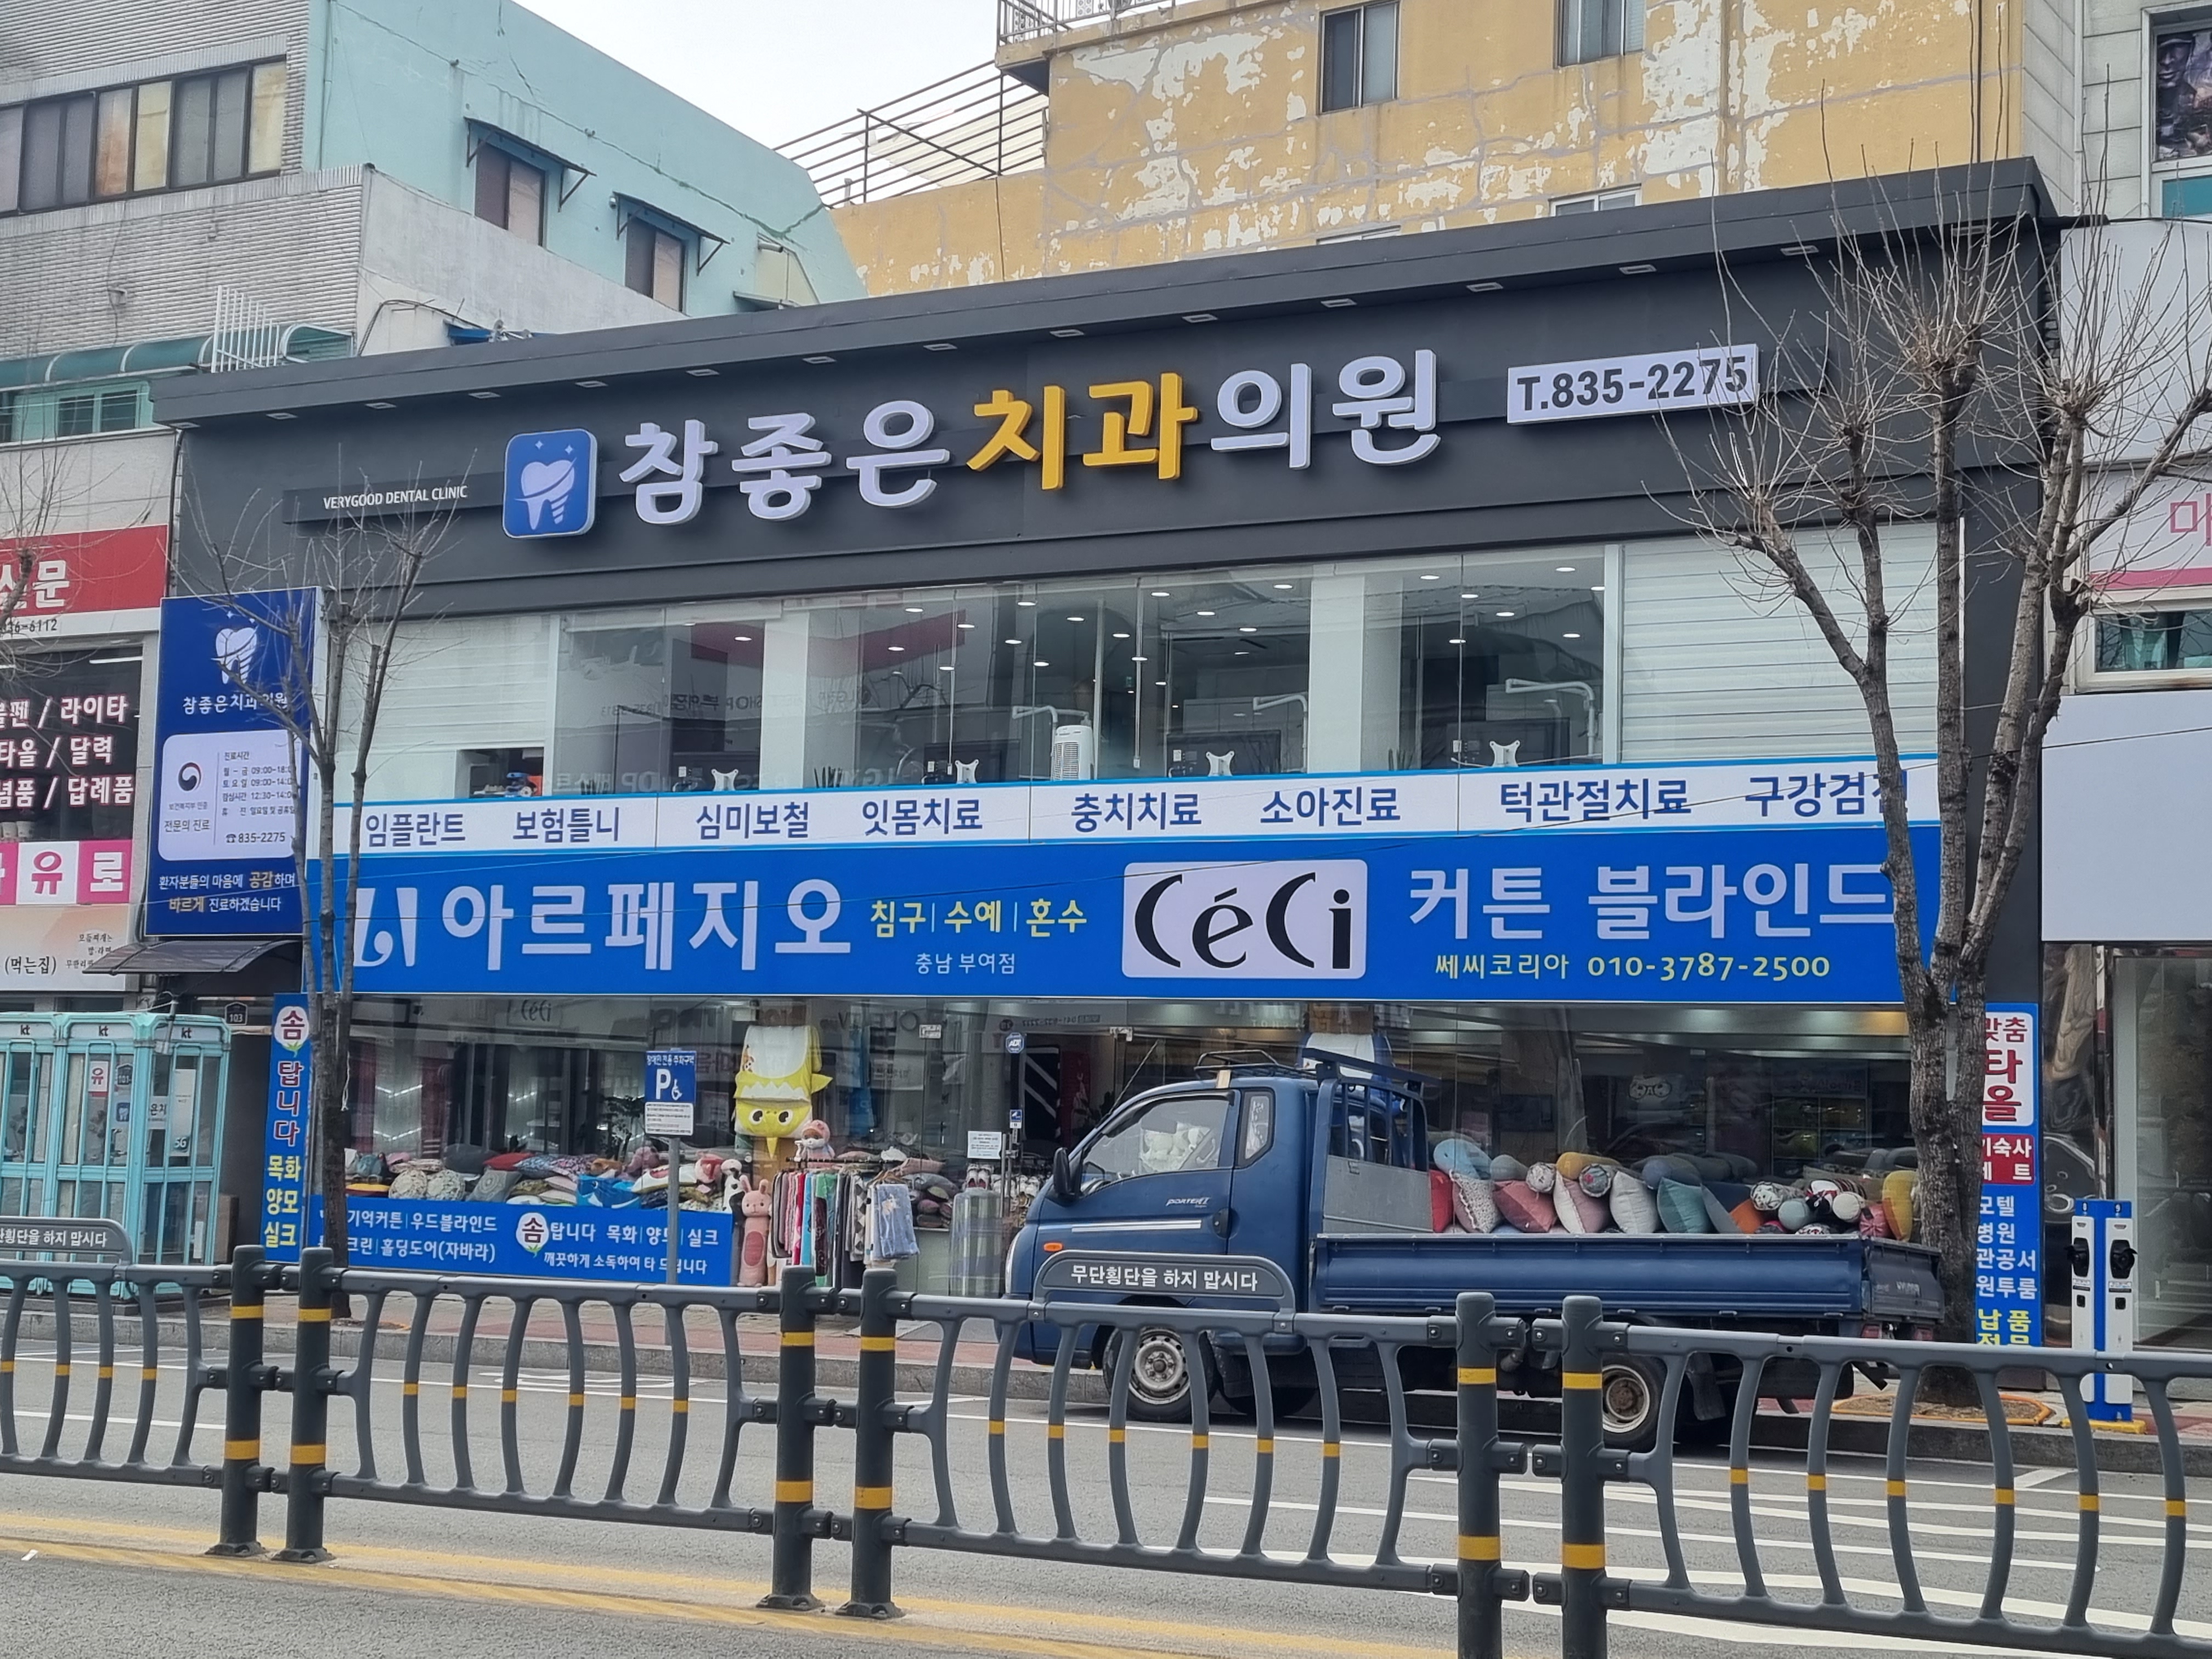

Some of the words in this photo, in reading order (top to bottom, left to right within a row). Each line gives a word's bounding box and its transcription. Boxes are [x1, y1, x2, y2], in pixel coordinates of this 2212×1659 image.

[1517, 356, 1748, 411] T.835-2275
[323, 493, 383, 509] VERYGOOD
[386, 489, 429, 505] DENTAL
[432, 485, 469, 501] CLINIC
[60, 695, 128, 725] 라이타
[70, 735, 112, 765] 달력
[67, 775, 134, 806] 답례품
[164, 819, 190, 833] 전문의
[193, 819, 211, 832] 진료
[366, 811, 466, 848] 임플란트
[512, 806, 620, 843] 보험틀니
[696, 802, 809, 840] 심미보철
[862, 797, 983, 836] 잇몸치료
[1071, 792, 1202, 833] 충치치료
[1260, 786, 1401, 827] 소아진료
[1500, 778, 1691, 823] 턱관절치료
[238, 832, 286, 844] 835-2275
[0, 851, 123, 895] 유로
[159, 874, 210, 890] 환자분들의
[212, 873, 243, 889] 마음에
[169, 896, 205, 913] 바르게
[208, 896, 281, 913] 진료하겠습니다
[1409, 867, 1550, 940] 커튼
[1588, 863, 1895, 940] 블라인드
[442, 879, 851, 970] 아르페지오
[870, 899, 926, 938] 침구
[944, 900, 1002, 934] 수예
[1026, 898, 1087, 938] 혼수
[915, 952, 952, 975] 충남
[958, 952, 1016, 975] 부여점
[1588, 952, 1831, 981] 010-3787-2500
[20, 1025, 31, 1036] kt
[98, 1026, 109, 1037] kt
[181, 1027, 192, 1039] kt
[280, 1010, 305, 1040] 솜
[656, 1069, 671, 1099] P
[267, 1155, 302, 1183] 목화
[266, 1189, 299, 1216] 양모
[1979, 1195, 2015, 1217] 모텔
[264, 1221, 297, 1249] 실크
[410, 1211, 498, 1233] 우드블라인드
[522, 1217, 544, 1243] 솜
[550, 1222, 596, 1242] 탑니다
[606, 1224, 637, 1244] 목화
[687, 1228, 719, 1246] 실크
[1978, 1222, 2015, 1244] 병원
[43, 1229, 66, 1246] 하지
[71, 1231, 108, 1248] 맙시다
[381, 1237, 495, 1263] 홀딩도어(자바라)
[544, 1251, 590, 1268] 깨끗하게
[593, 1256, 640, 1271] 소독하여
[1976, 1248, 2036, 1272] 관공서
[1071, 1265, 1158, 1288] 무단횡단을
[1163, 1268, 1198, 1289] 하지
[1204, 1270, 1259, 1292] 맙시다
[1976, 1276, 2038, 1300] 원투룸
